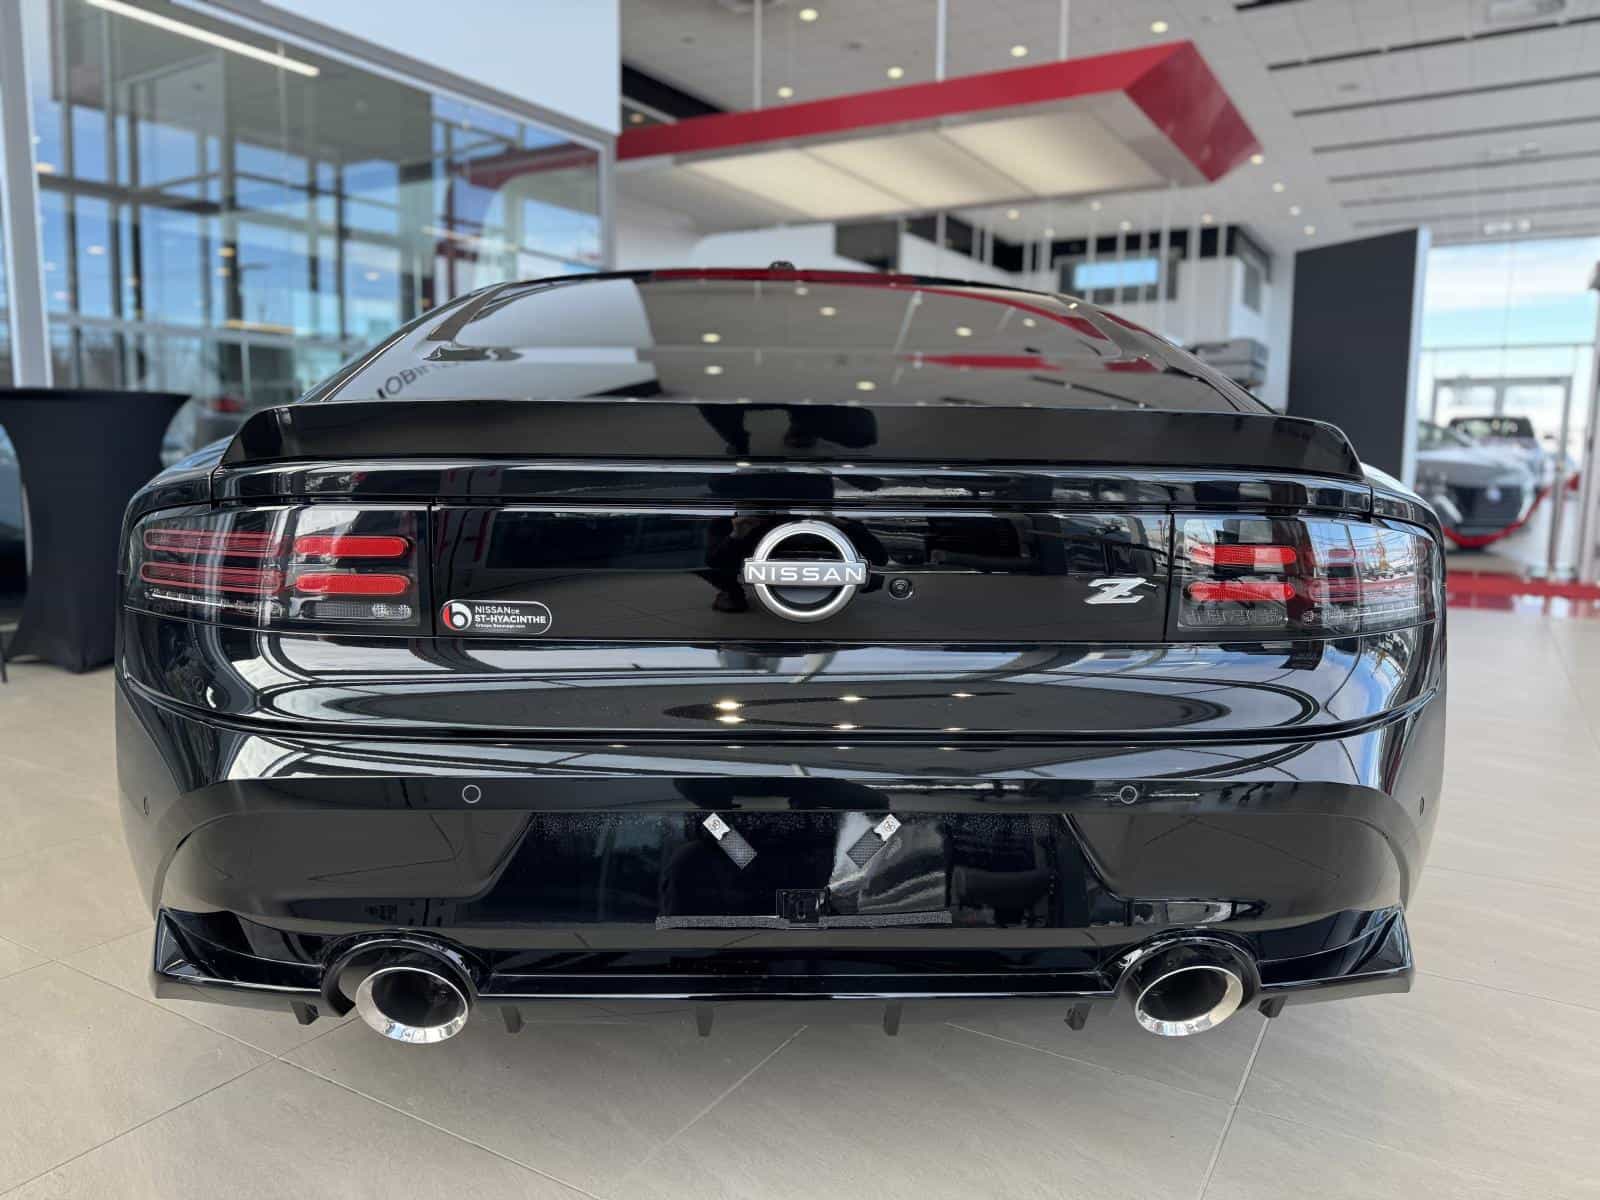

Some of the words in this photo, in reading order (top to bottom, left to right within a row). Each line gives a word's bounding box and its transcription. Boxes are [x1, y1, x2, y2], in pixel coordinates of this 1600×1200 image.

[748, 566, 862, 581] NISSAN
[475, 606, 511, 614] NISSAN
[475, 614, 547, 624] ST-HYACINTHE
